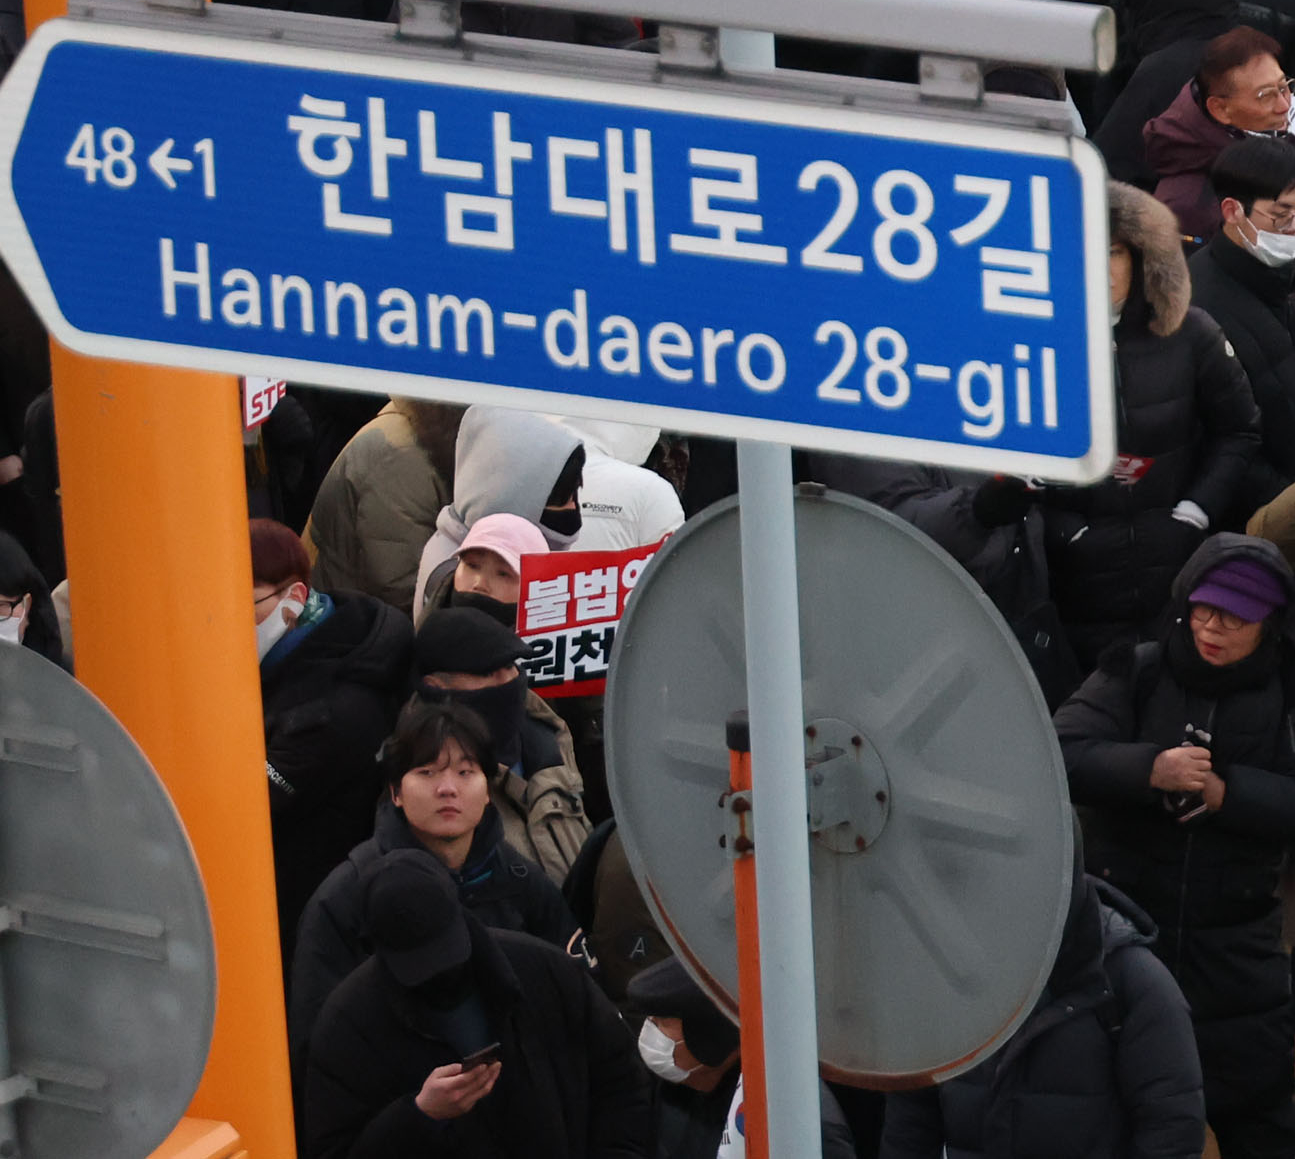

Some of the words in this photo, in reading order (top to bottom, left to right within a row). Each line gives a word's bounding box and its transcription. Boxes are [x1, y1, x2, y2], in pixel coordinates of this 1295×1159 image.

[287, 94, 1054, 318] 한남대로28길
[160, 238, 787, 393] Hannam-daero
[814, 319, 1058, 439] 28-gil
[251, 380, 288, 419] STE
[520, 626, 615, 688] 원천
